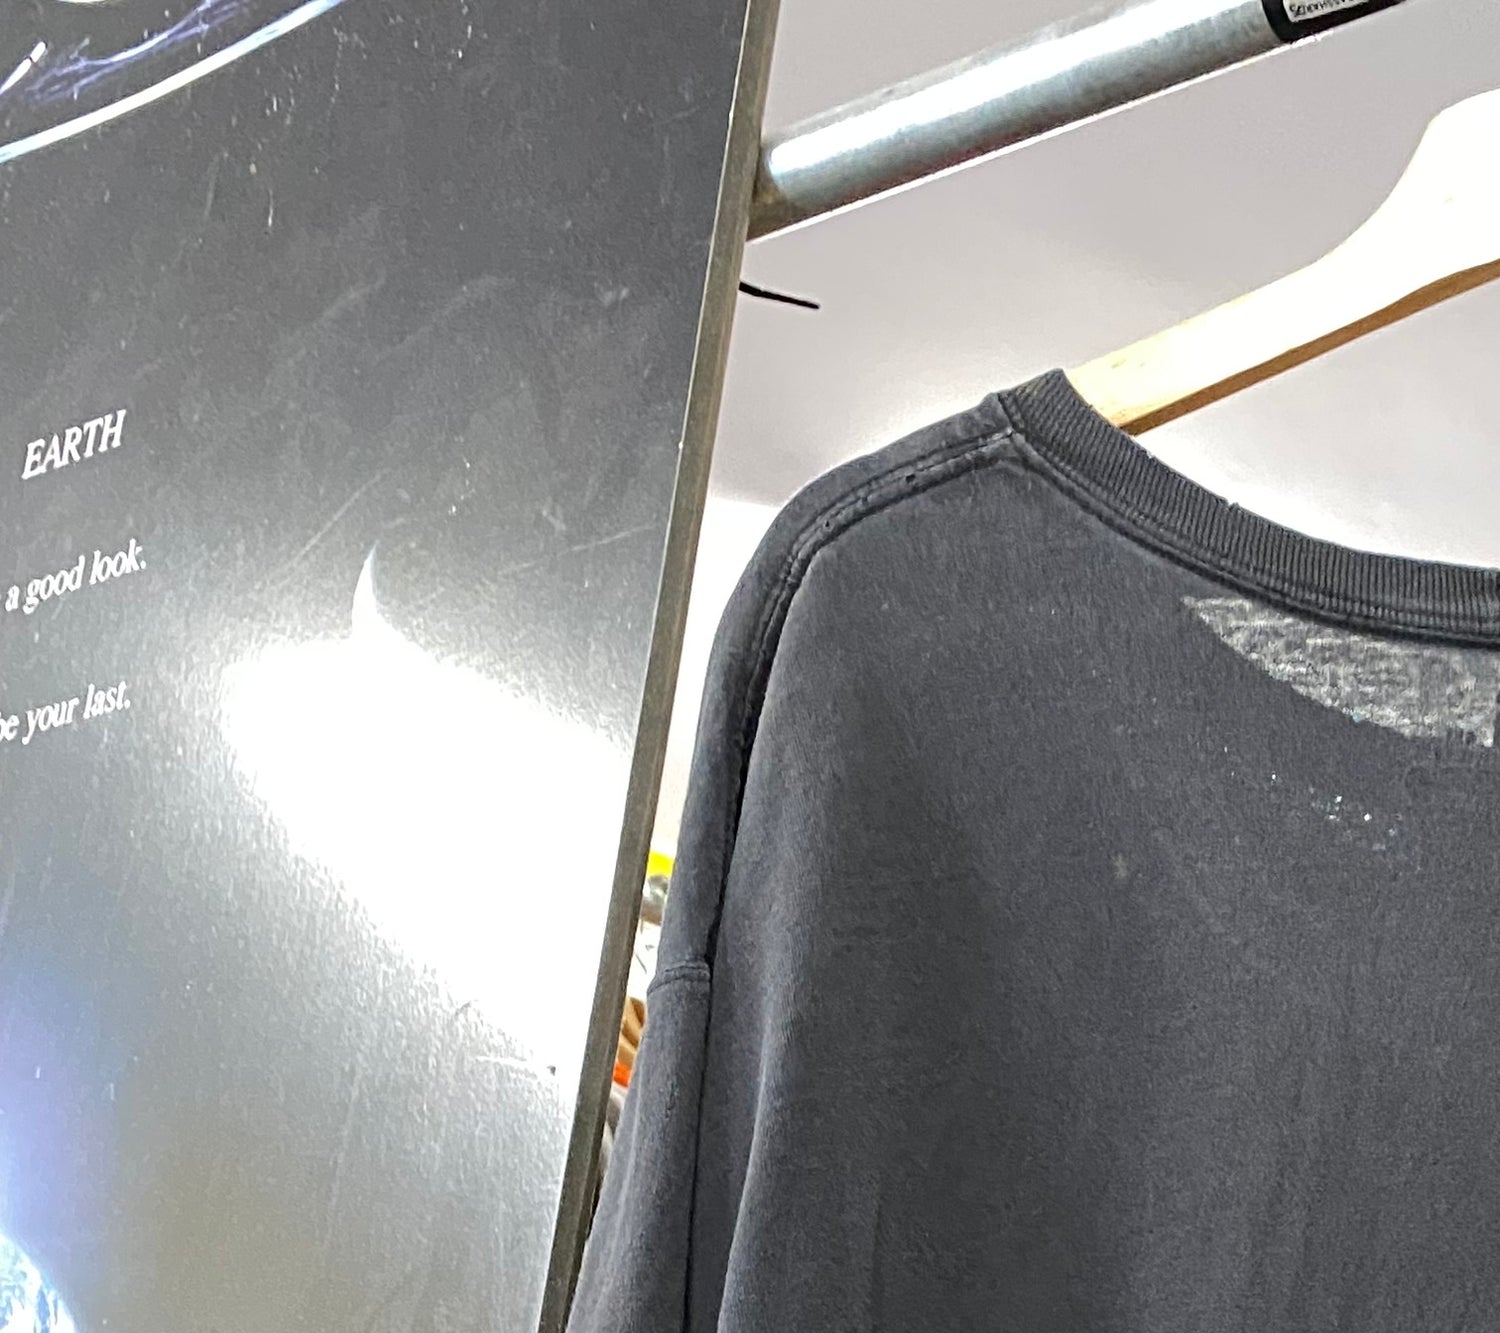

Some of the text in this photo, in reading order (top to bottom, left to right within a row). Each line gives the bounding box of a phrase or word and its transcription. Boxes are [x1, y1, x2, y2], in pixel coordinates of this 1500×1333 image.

[21, 409, 127, 480] EARTH
[4, 537, 147, 615] a good look.
[21, 696, 80, 746] your
[82, 680, 131, 720] last.
